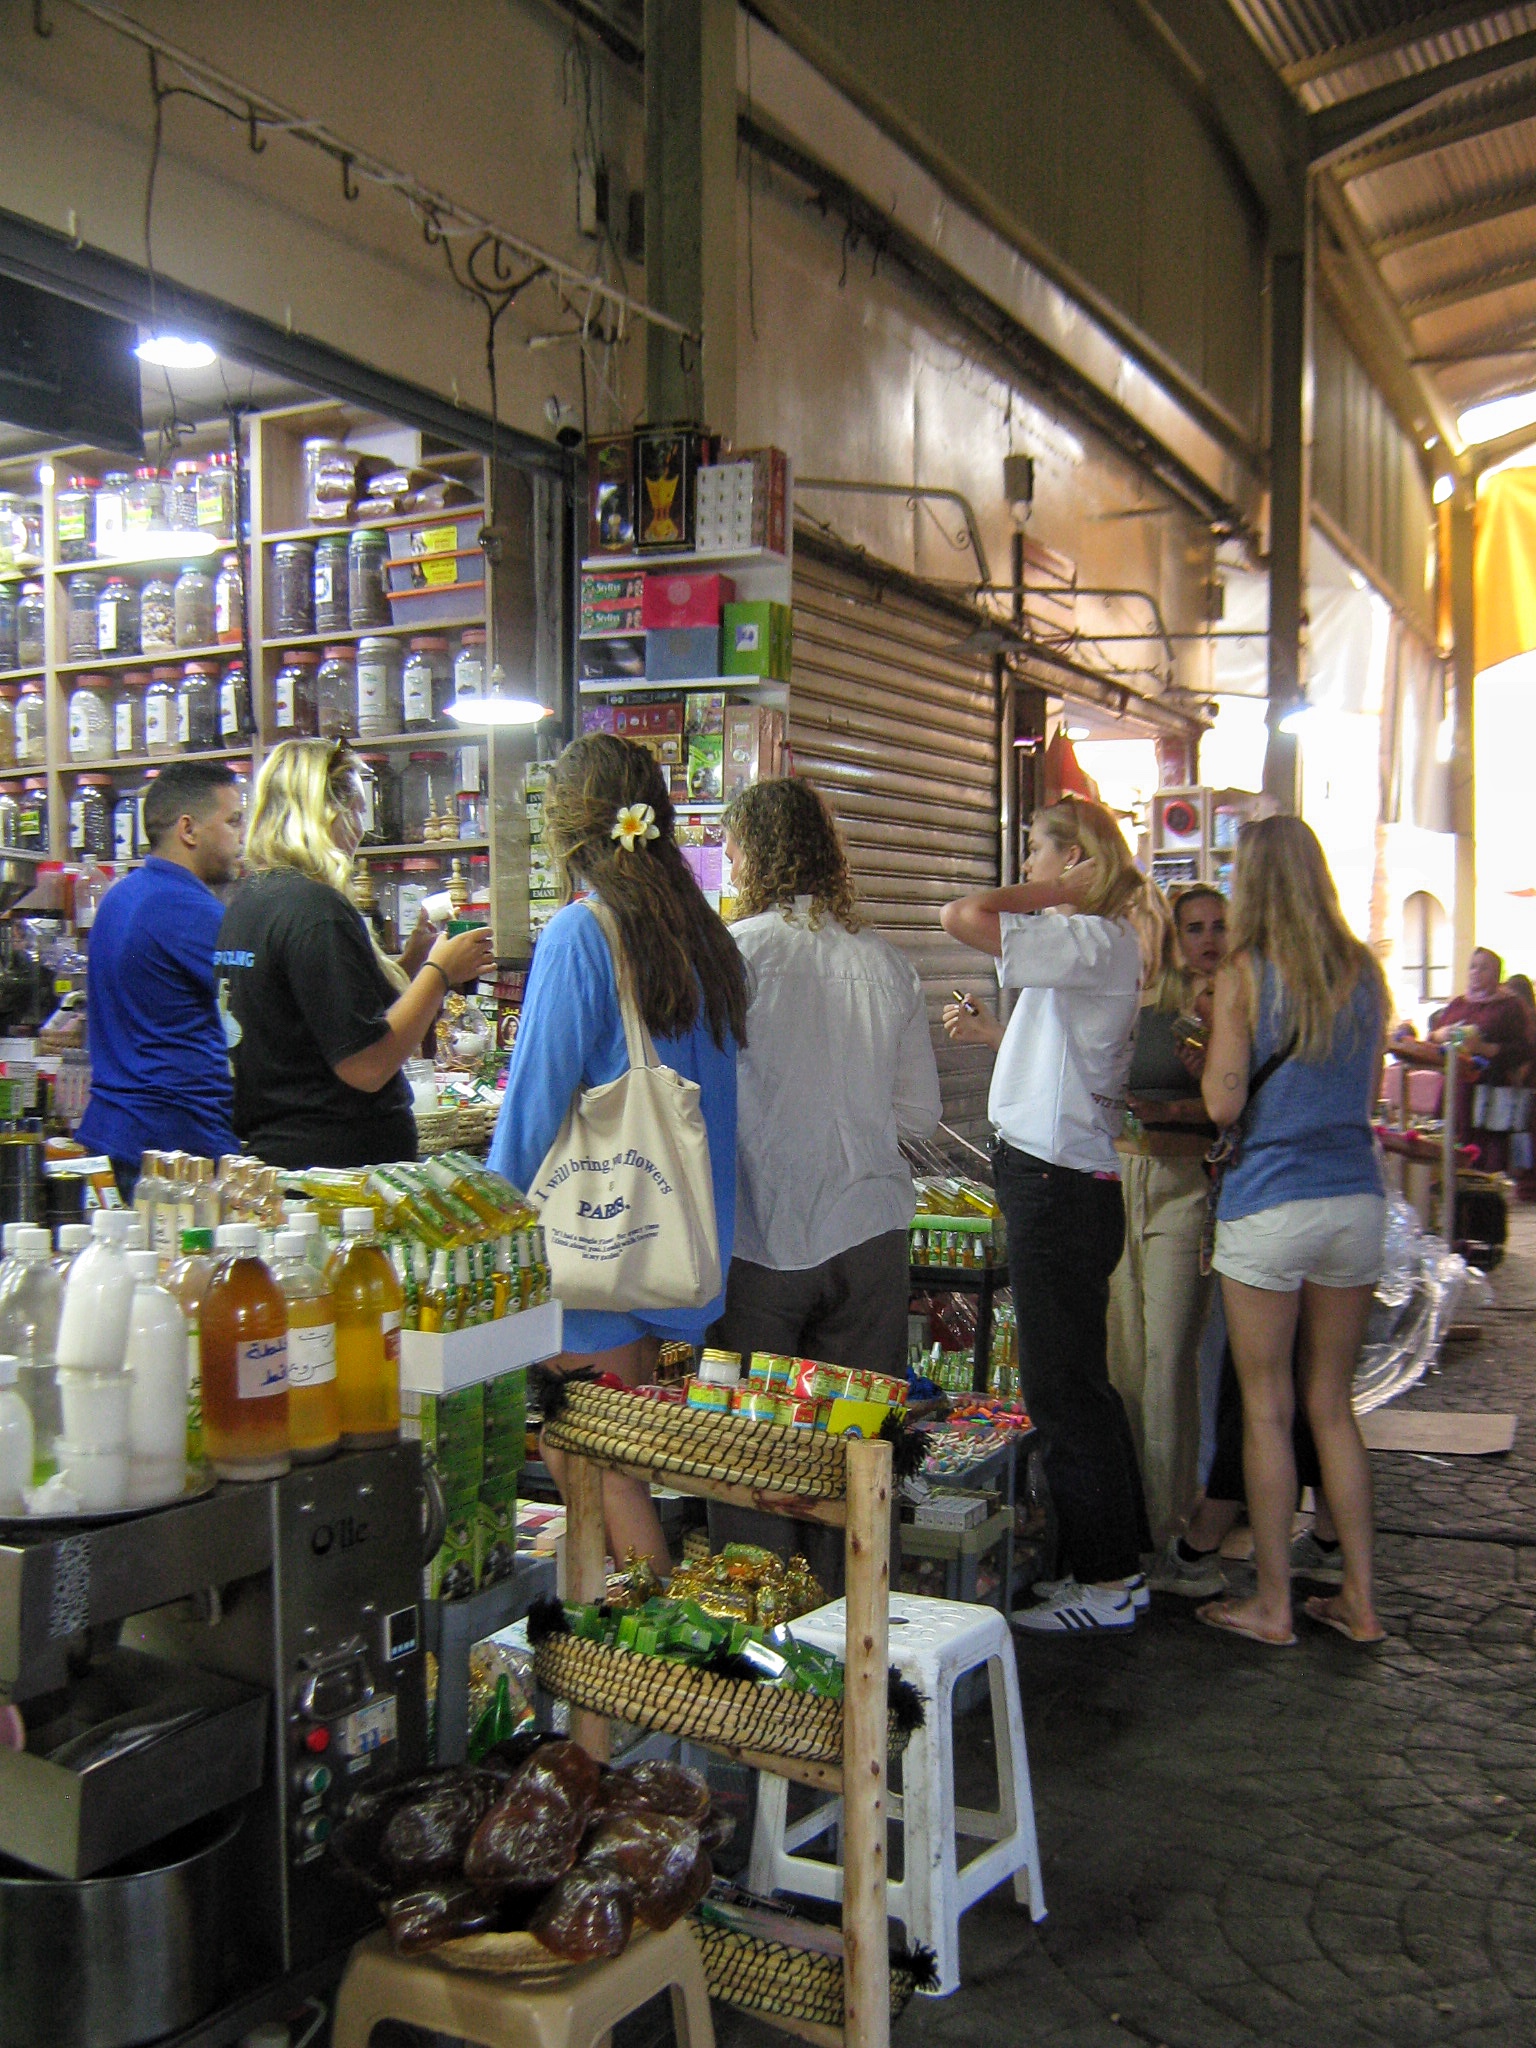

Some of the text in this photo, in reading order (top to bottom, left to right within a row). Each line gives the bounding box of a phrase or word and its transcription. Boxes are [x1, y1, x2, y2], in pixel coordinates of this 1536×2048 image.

[534, 1188, 549, 1202] I
[546, 1163, 571, 1189] will
[569, 1156, 611, 1174] bring
[623, 1149, 673, 1195] flowers
